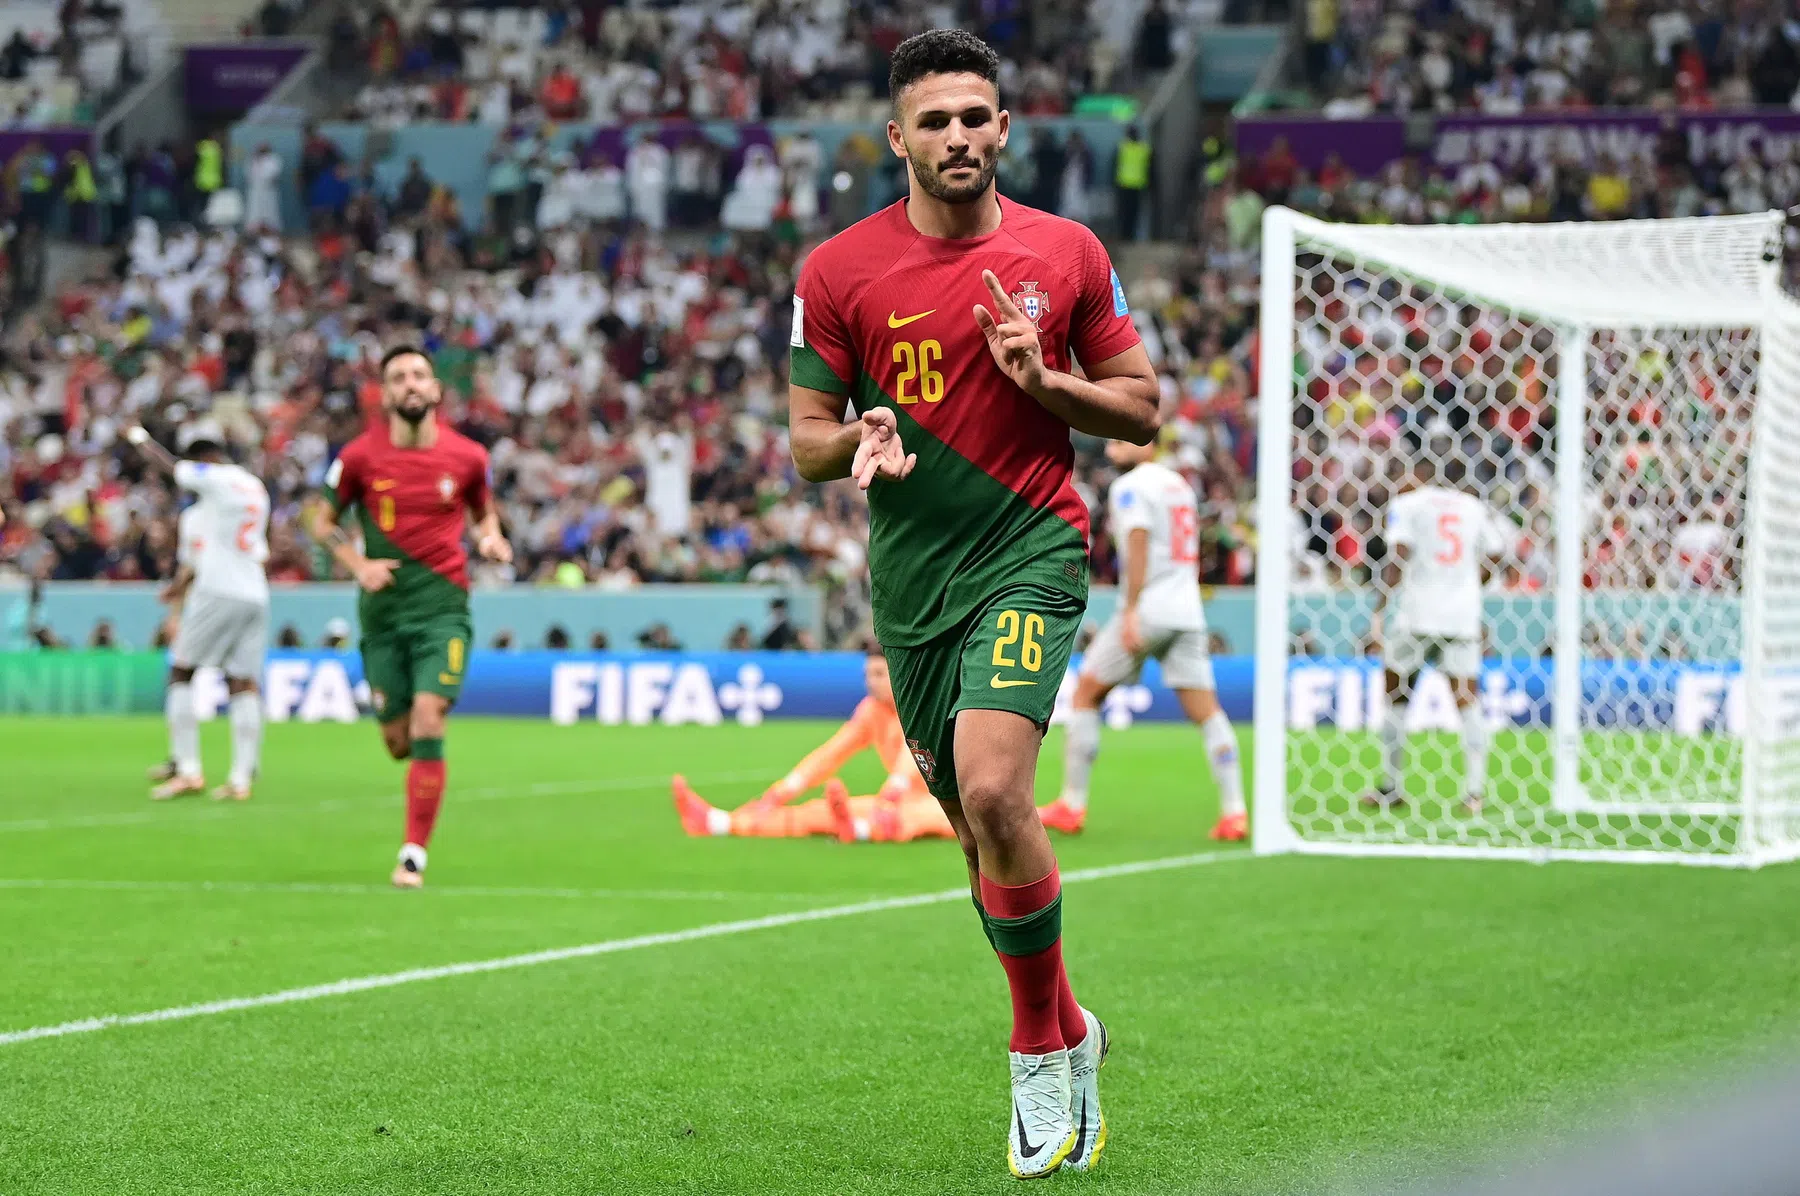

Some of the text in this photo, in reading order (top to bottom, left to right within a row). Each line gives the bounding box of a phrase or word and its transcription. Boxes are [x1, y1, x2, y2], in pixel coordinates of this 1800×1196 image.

[893, 339, 944, 404] 26
[1435, 513, 1463, 566] 5
[992, 609, 1045, 672] 26
